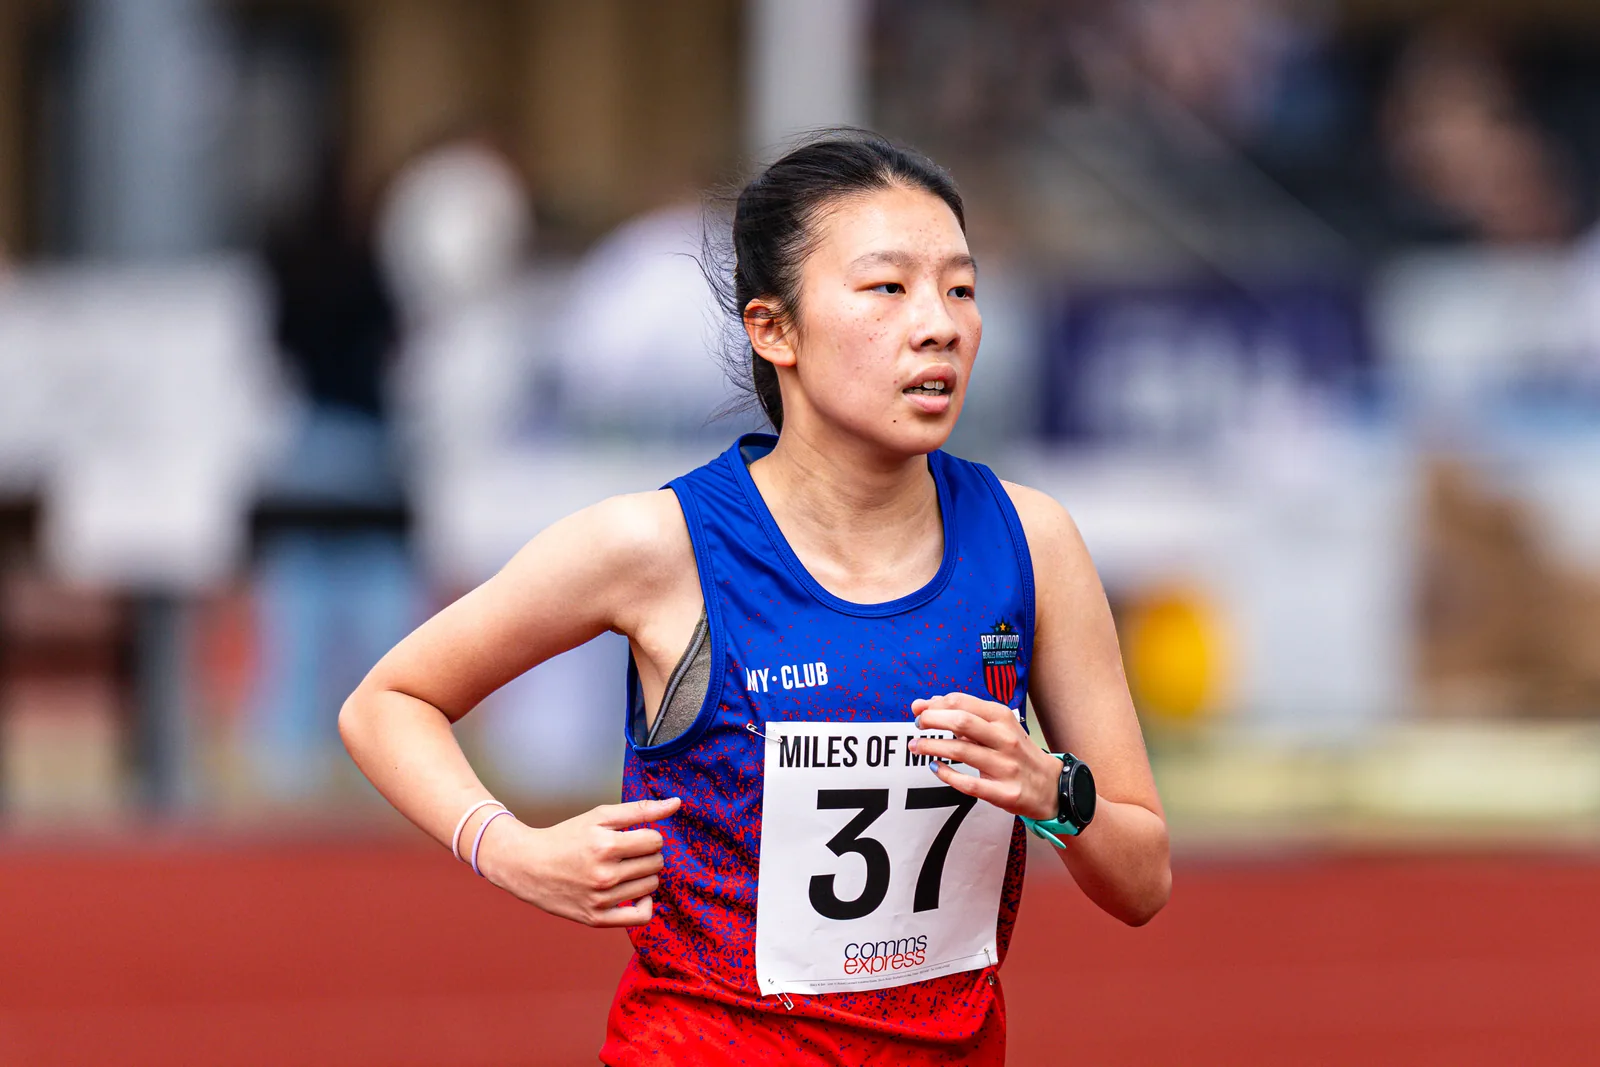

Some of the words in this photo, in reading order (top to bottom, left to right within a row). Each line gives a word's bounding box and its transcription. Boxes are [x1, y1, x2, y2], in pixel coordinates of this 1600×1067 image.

[980, 634, 1020, 650] BRENTWOOD
[778, 735, 858, 768] MILES
[865, 735, 898, 767] OF
[808, 785, 979, 921] 37
[844, 934, 928, 959] comms
[843, 949, 926, 975] express
